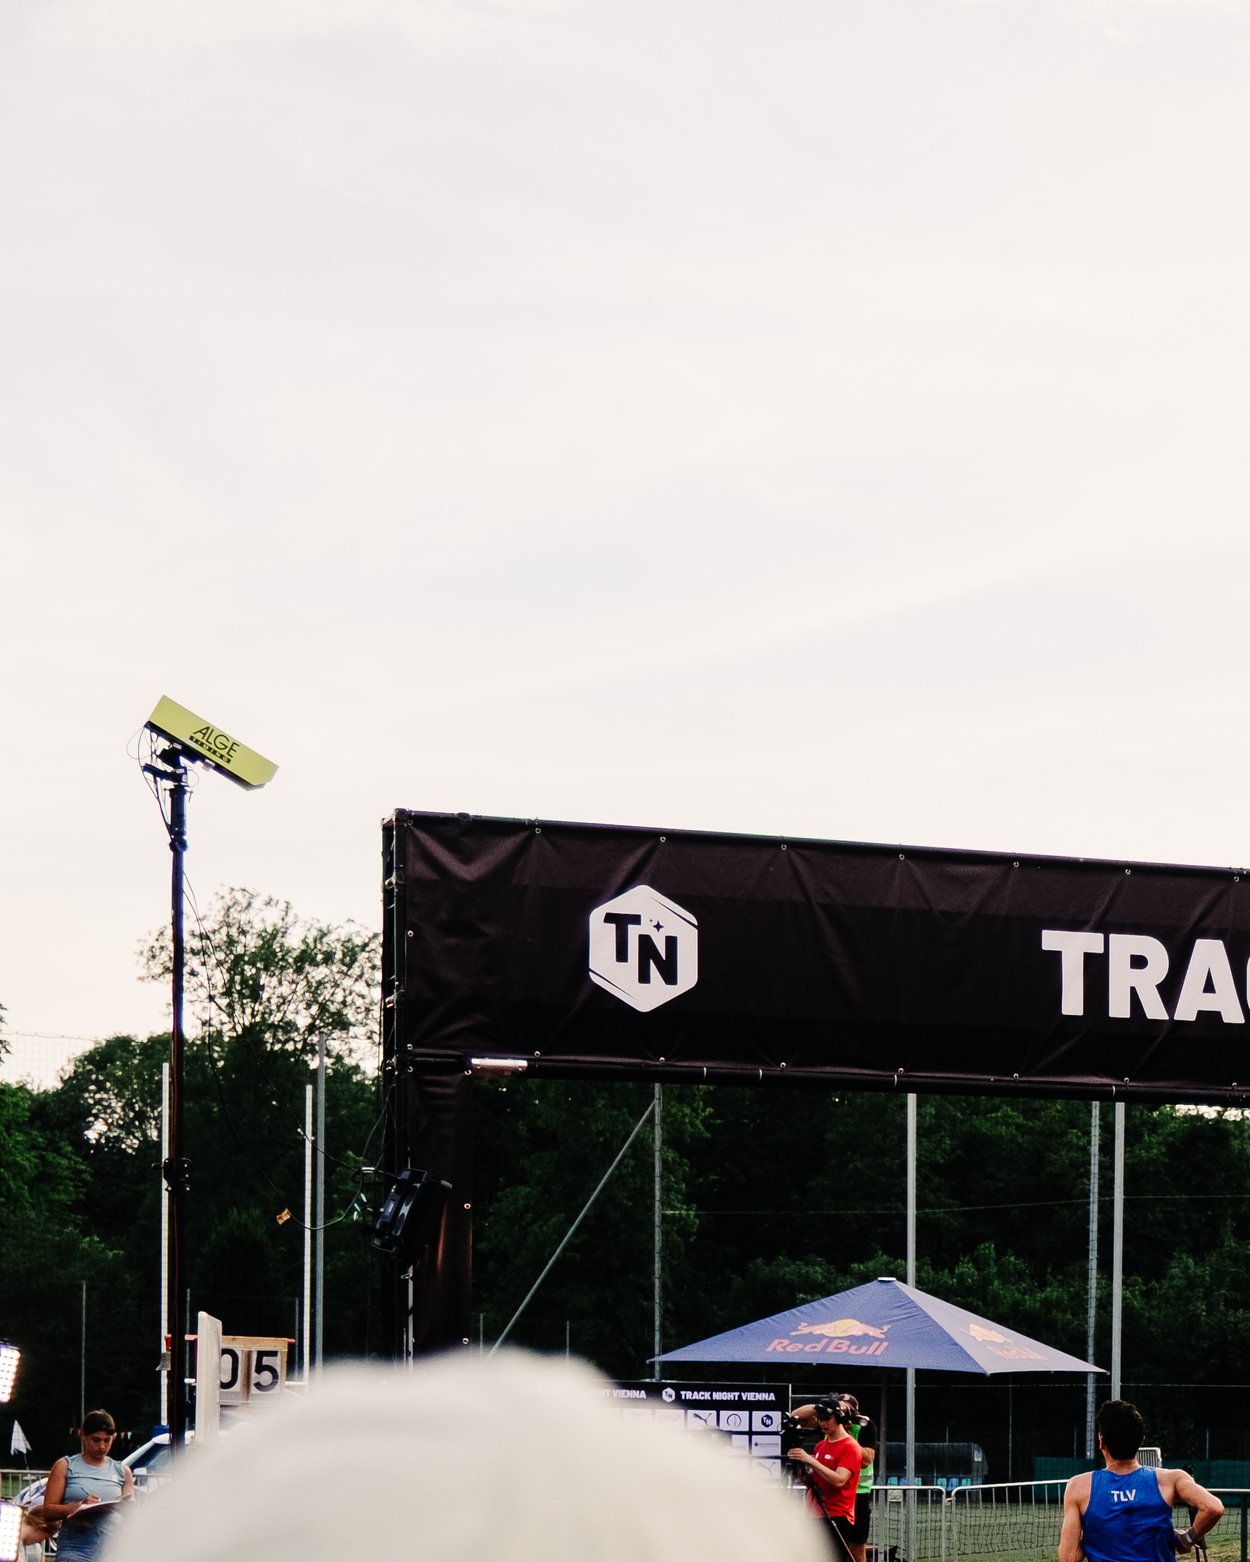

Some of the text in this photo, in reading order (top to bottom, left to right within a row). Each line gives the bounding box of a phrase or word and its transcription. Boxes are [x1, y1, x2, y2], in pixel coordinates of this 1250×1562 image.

[193, 726, 240, 758] ALGE
[604, 913, 677, 985] TN
[766, 1338, 889, 1356] Red Bull
[612, 1389, 647, 1399] VIENNA
[680, 1391, 712, 1400] TRACK
[712, 1391, 740, 1400] NIGHT
[741, 1392, 776, 1401] VIENNA
[1111, 1489, 1137, 1502] TLV
